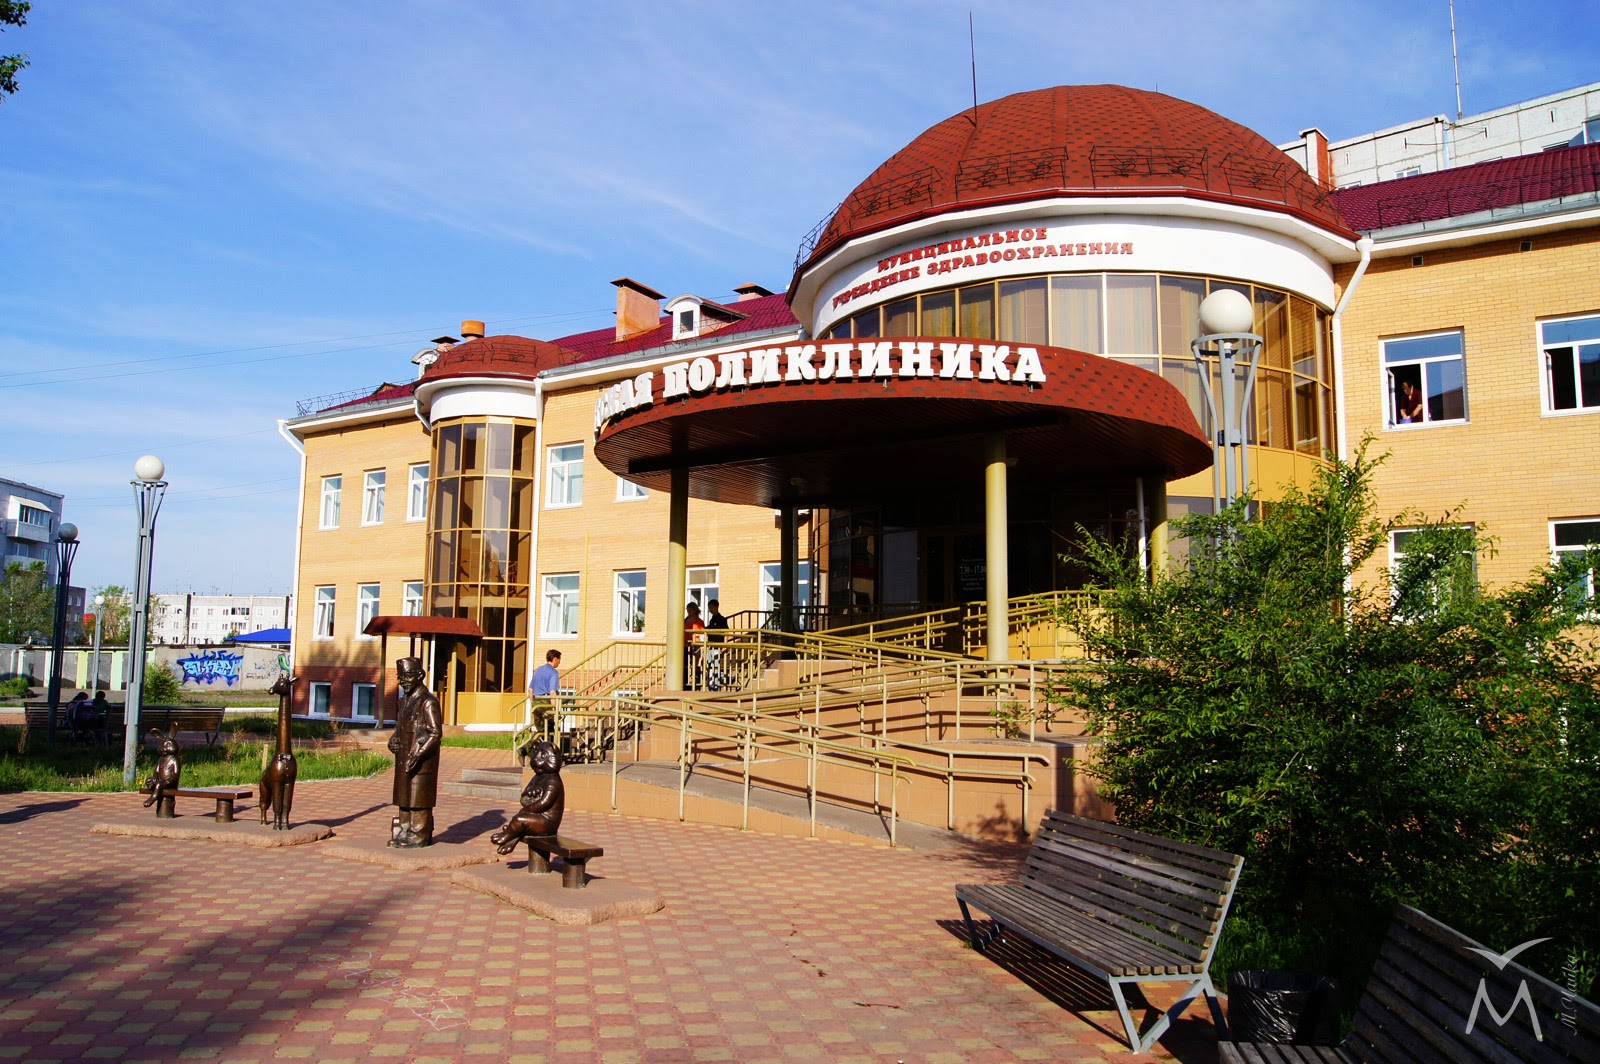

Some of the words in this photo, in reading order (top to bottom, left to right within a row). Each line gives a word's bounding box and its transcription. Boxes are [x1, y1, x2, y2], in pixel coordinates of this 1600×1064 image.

[832, 266, 920, 309] УЧРЕЖДЕНИЕ
[927, 242, 1134, 275] ЗДРАВООХРАНЕНИЯ
[877, 227, 1047, 273] МУНИЦИПАЛЬНОЕ
[662, 341, 1046, 398] ПОЛИКЛИНИКА
